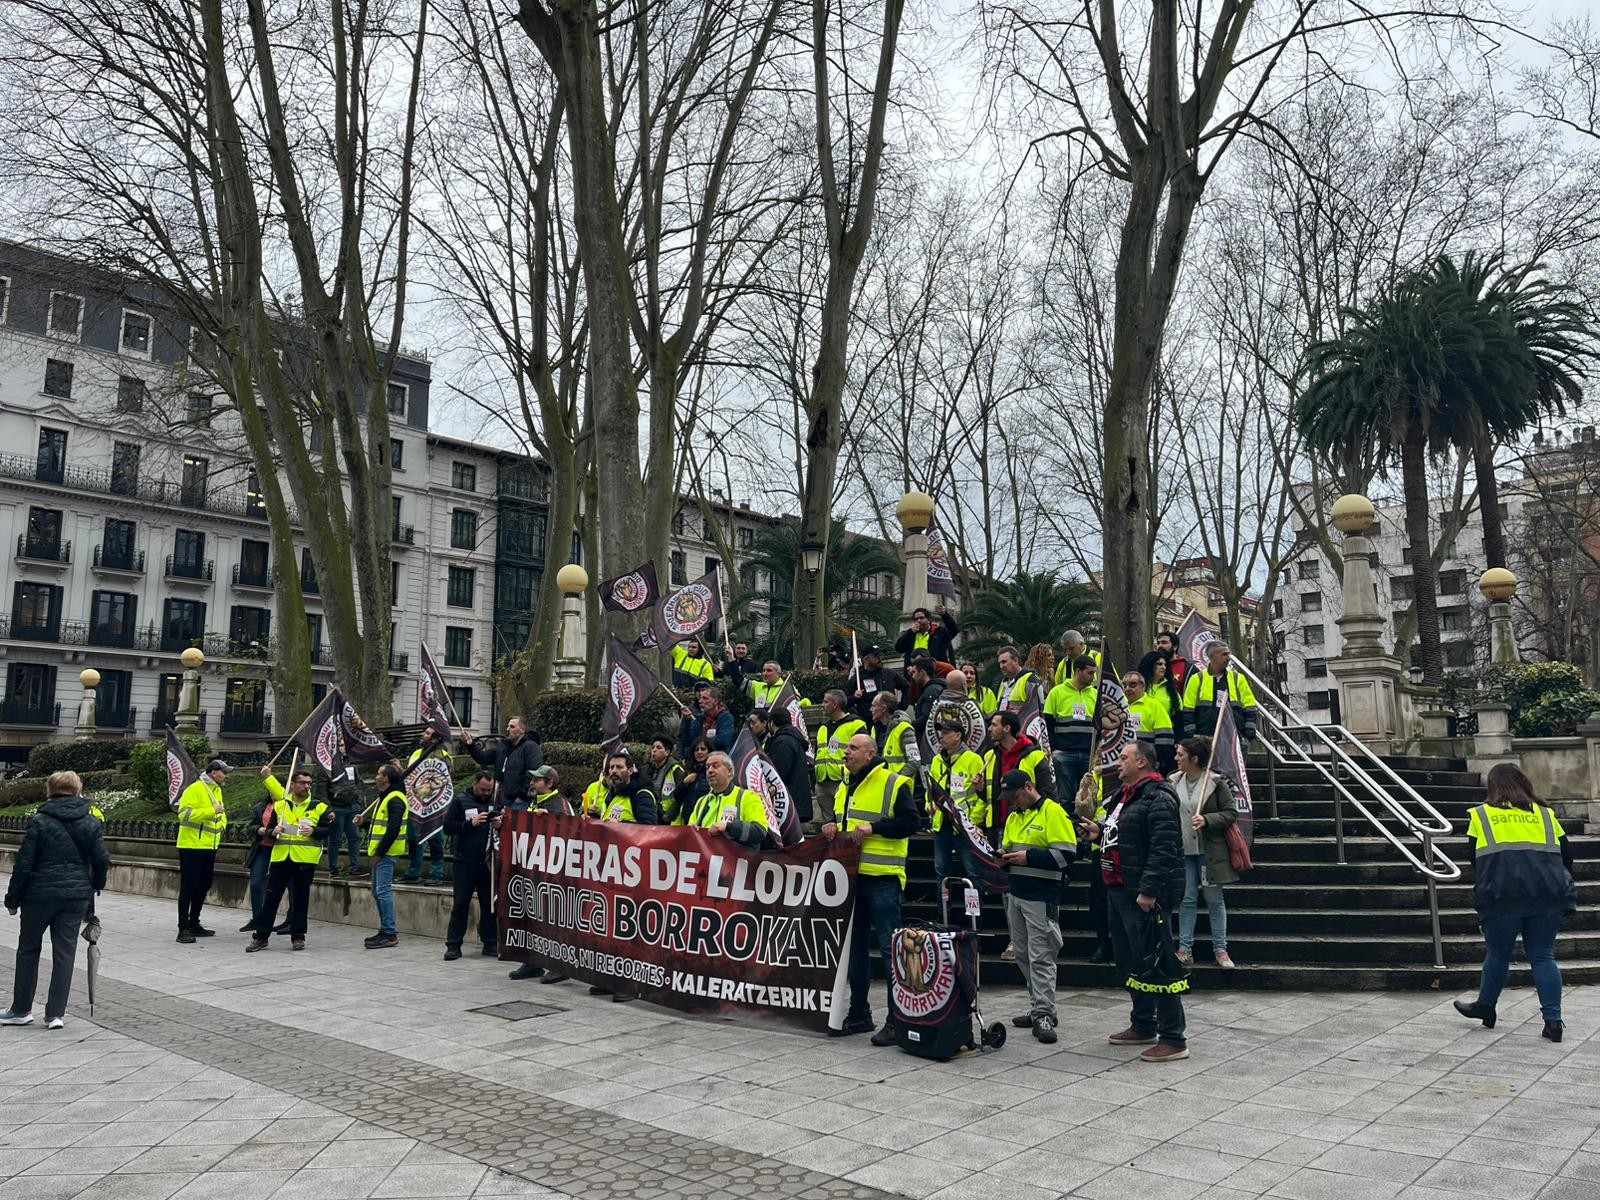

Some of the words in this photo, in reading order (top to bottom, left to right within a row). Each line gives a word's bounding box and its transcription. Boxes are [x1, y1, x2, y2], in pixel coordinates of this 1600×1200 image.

[1491, 814, 1540, 825] garnica
[511, 831, 641, 887] MADERAS
[650, 849, 701, 895] DE
[707, 854, 849, 907] LLODIO
[508, 875, 608, 937] garnica
[613, 895, 845, 969] BORROKAN
[506, 928, 525, 948] NI
[579, 948, 595, 970] NI
[595, 953, 664, 988] RECORTES
[672, 970, 817, 1011] KALERATZERIK
[820, 990, 834, 1013] E
